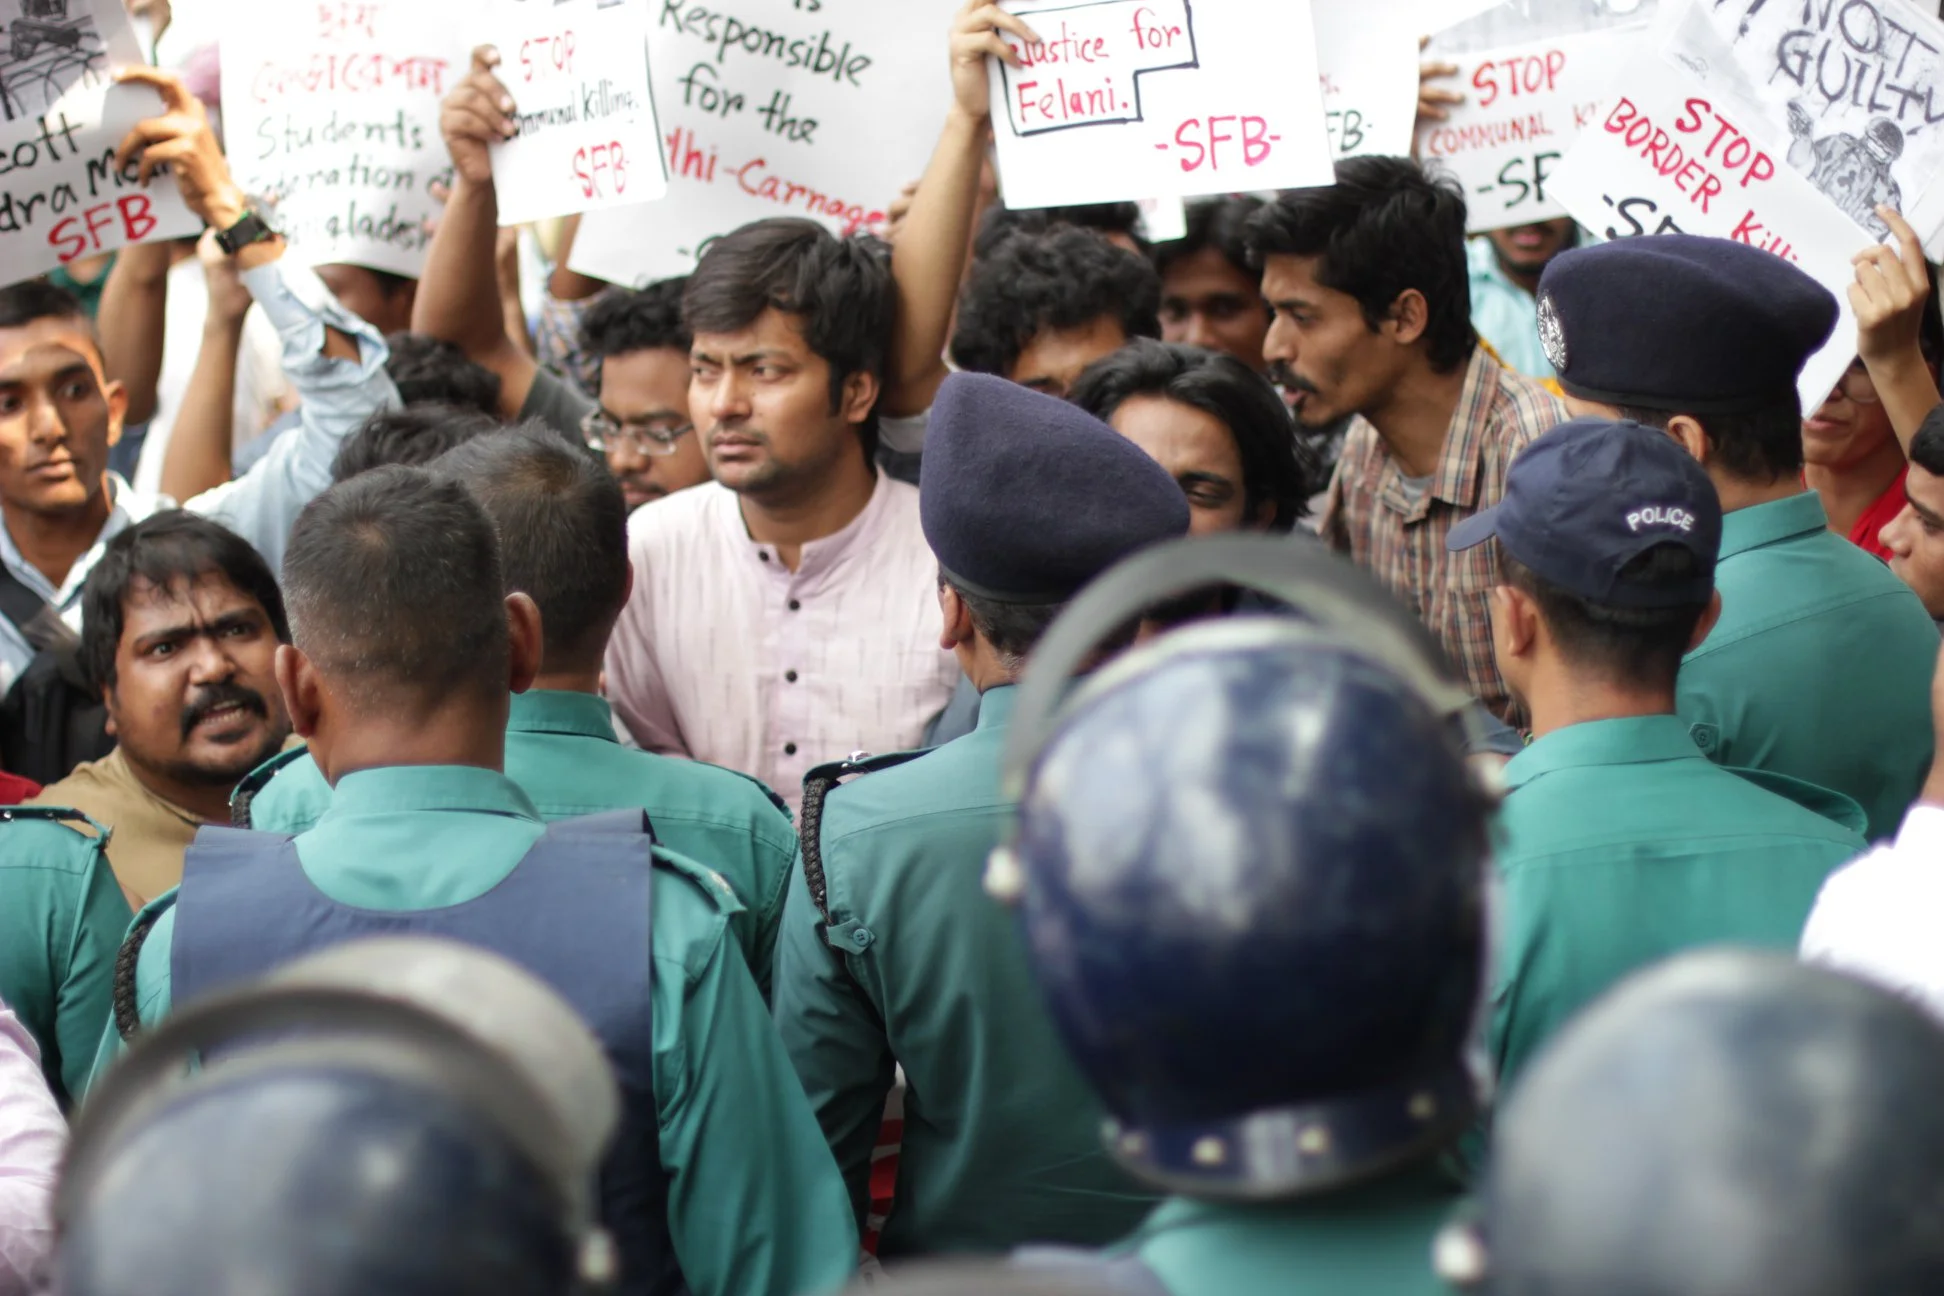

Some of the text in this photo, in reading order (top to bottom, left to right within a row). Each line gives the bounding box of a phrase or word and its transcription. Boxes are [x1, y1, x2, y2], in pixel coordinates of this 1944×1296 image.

[519, 29, 576, 82] STOP
[659, 0, 871, 87] Responsible
[1129, 8, 1181, 49] for
[677, 62, 818, 145] for the
[1017, 77, 1129, 123] Felani.
[1472, 50, 1566, 107] STOP
[257, 108, 422, 160] Students
[1154, 115, 1281, 172] -SFB-
[1428, 110, 1556, 157] COMMUNAL
[1604, 97, 1722, 214] BORDER
[1675, 98, 1775, 188] STOP
[48, 194, 157, 263] SFB
[1625, 506, 1695, 532] POLICE
